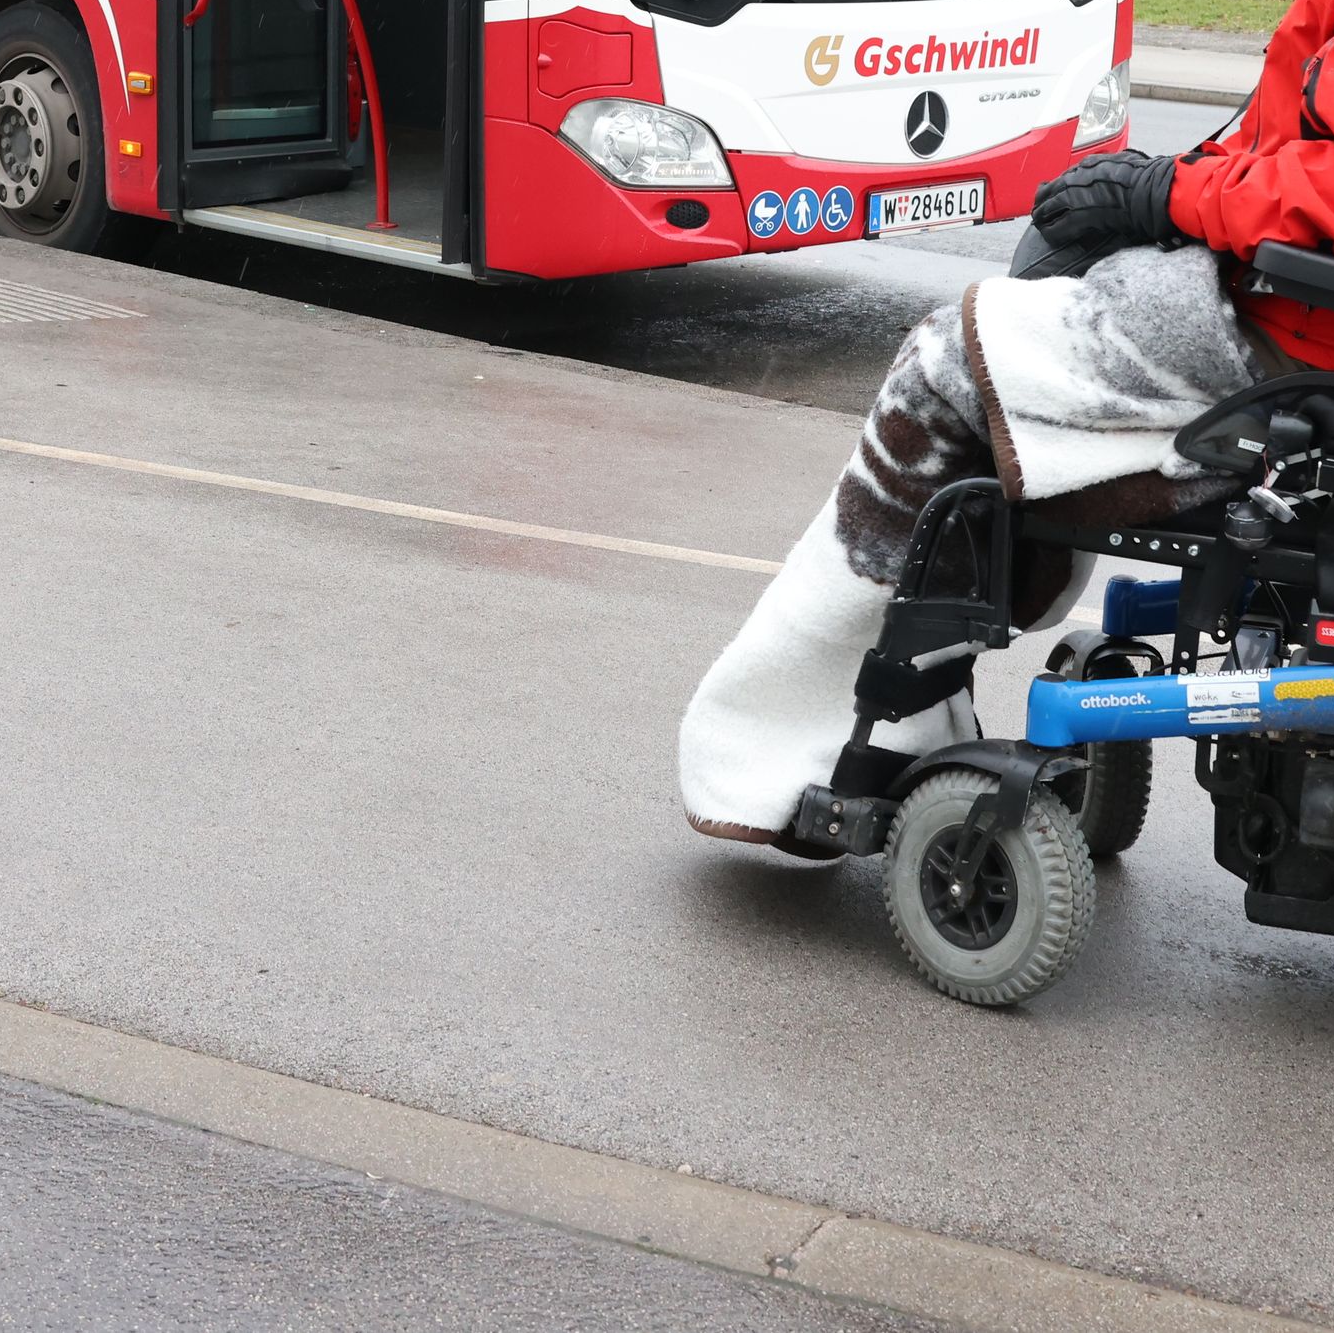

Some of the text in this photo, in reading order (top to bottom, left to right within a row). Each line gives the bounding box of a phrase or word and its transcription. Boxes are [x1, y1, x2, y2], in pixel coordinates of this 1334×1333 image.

[854, 28, 1040, 77] Gschwindl
[978, 88, 1041, 103] CITARO
[884, 198, 897, 224] W
[1080, 691, 1152, 709] ottobock.
